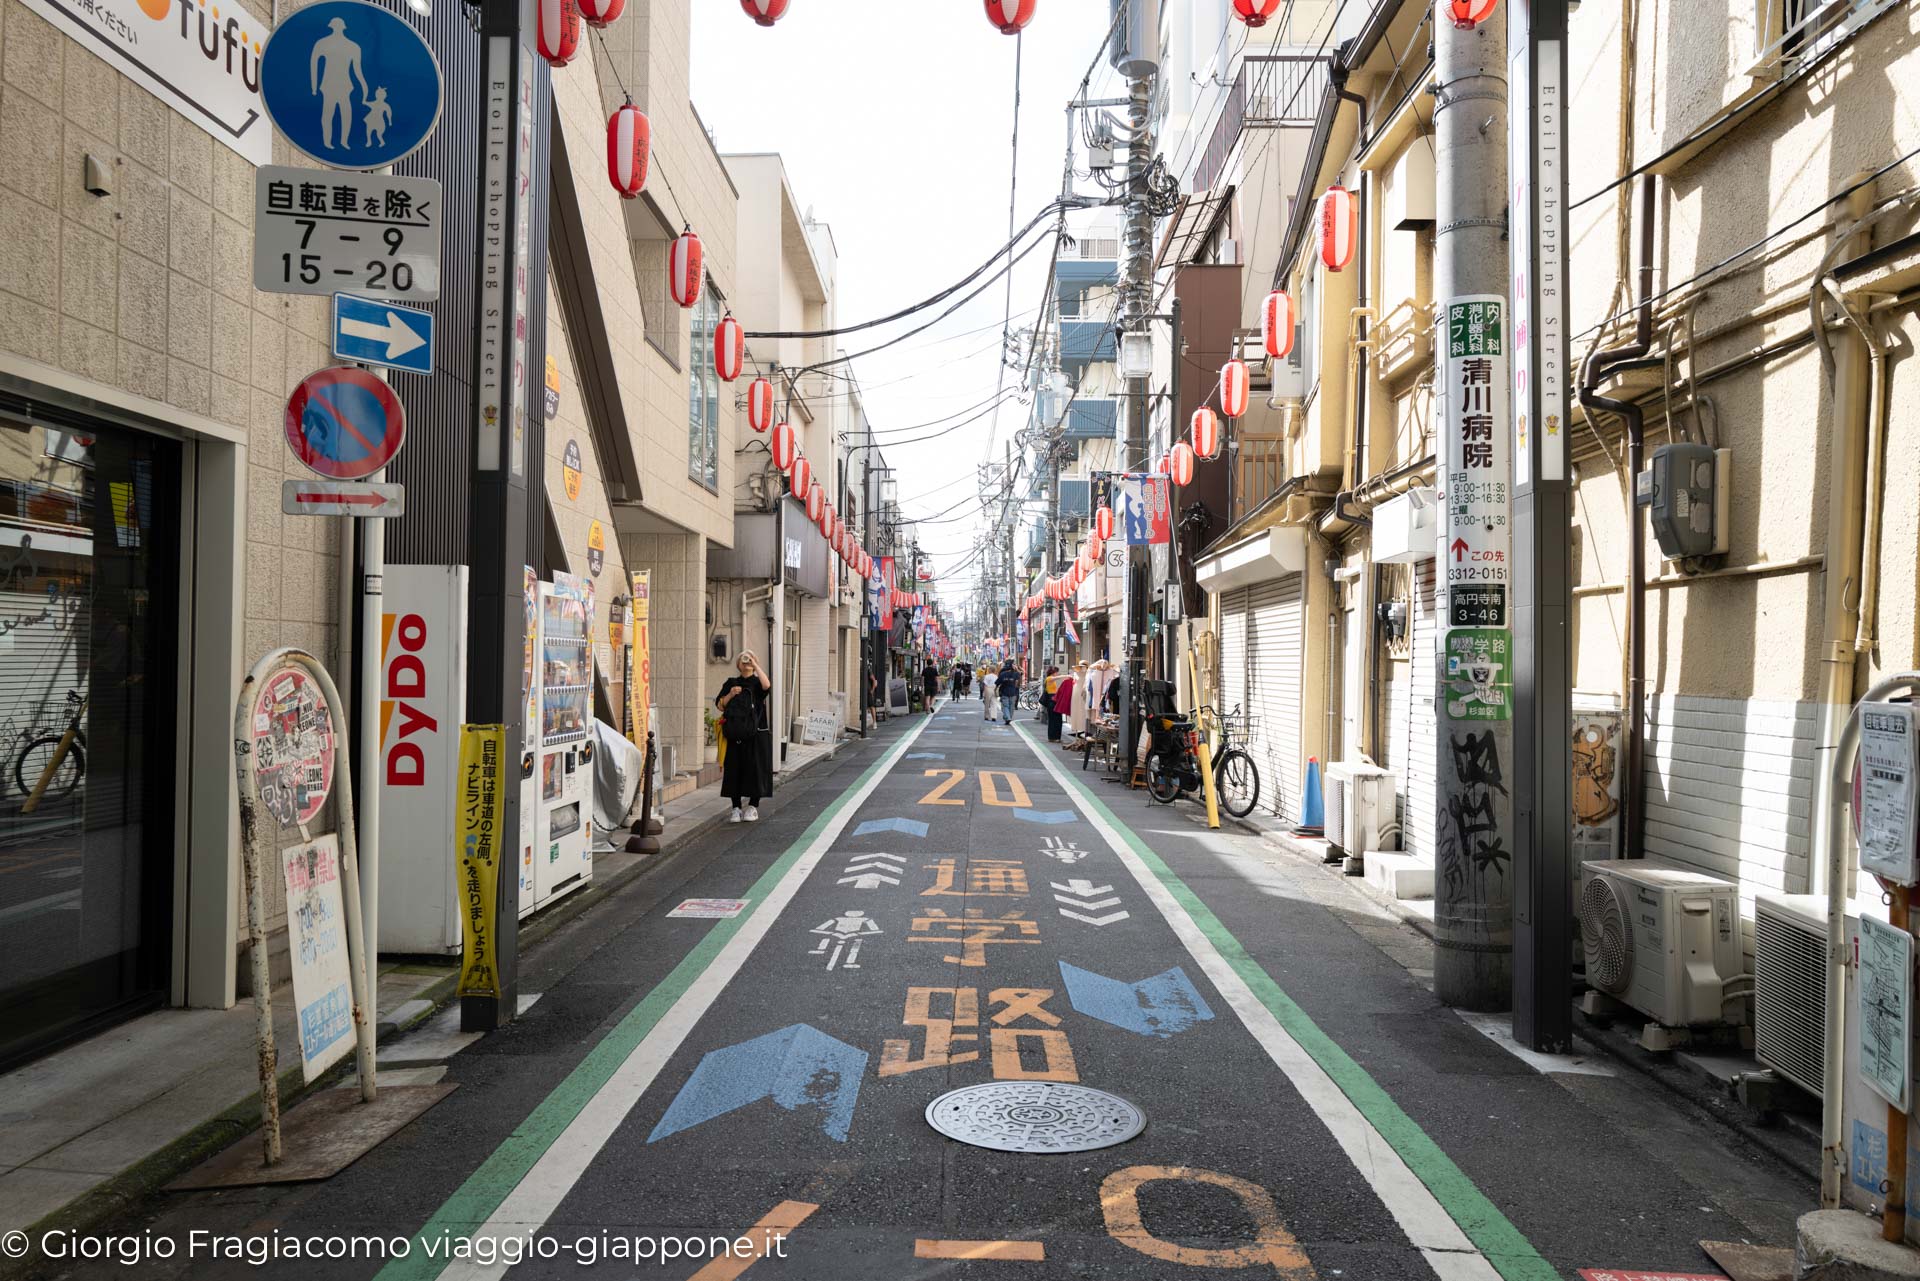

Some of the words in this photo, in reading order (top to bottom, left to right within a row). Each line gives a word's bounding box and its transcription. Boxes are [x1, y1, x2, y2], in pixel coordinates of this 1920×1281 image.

[491, 80, 505, 162] Etoile
[1543, 85, 1556, 168] Etoile
[268, 180, 430, 221] 自転車を除く
[486, 179, 502, 289] shopping
[1542, 186, 1557, 297] shopping
[484, 308, 499, 389] Street
[1451, 306, 1464, 355] 皮フ科
[1468, 303, 1483, 354] 消化器内科
[1544, 316, 1558, 398] Street
[1462, 357, 1493, 470] 清川病院
[1450, 472, 1468, 483] 平日
[1450, 493, 1506, 505] 13:30-16:30
[1454, 482, 1506, 494] 9:00-11:30
[1450, 504, 1469, 515] 土曜
[1454, 515, 1506, 526] 9:00-11:30
[1448, 566, 1508, 580] 3312-0151
[1471, 550, 1505, 562] この先
[1455, 593, 1502, 606] 高円寺南
[1458, 608, 1499, 621] 3-46
[386, 613, 438, 786] DyDo
[465, 762, 480, 831] ナビライン
[476, 739, 497, 860] 自転車は車道の左側
[916, 768, 1034, 807] 20
[467, 865, 486, 961] を走りましょう
[878, 858, 1081, 1082] 通学路
